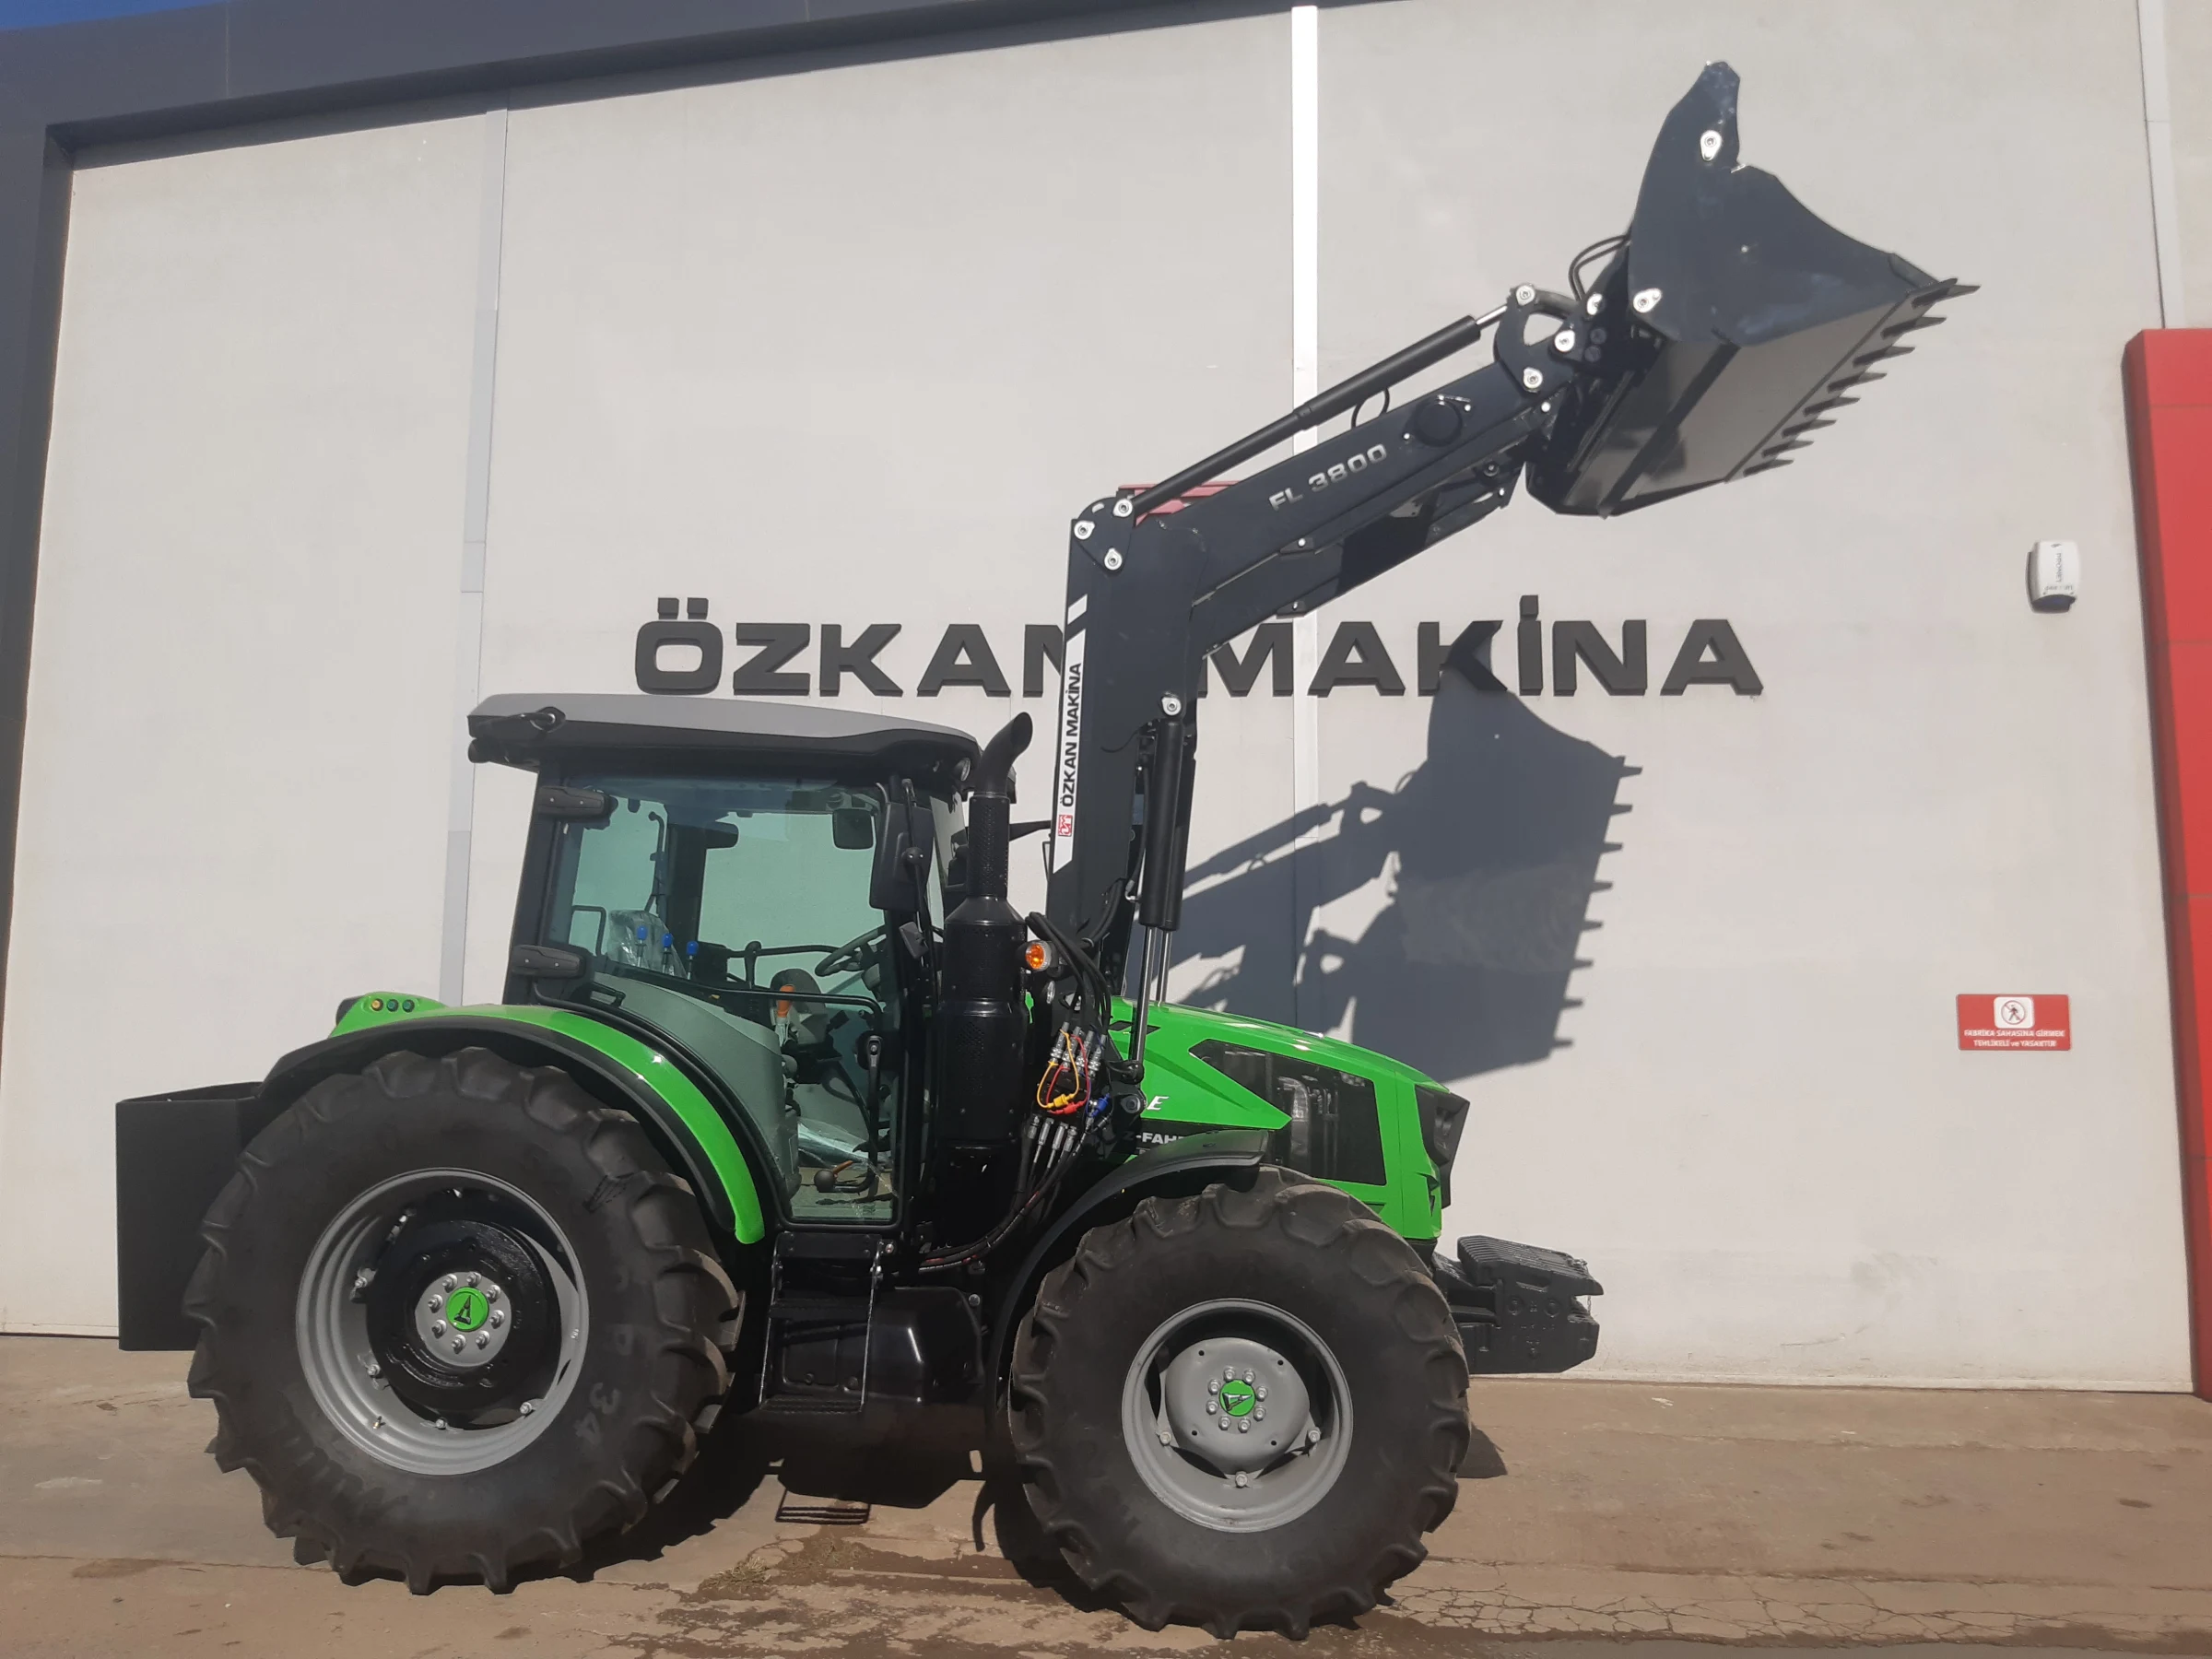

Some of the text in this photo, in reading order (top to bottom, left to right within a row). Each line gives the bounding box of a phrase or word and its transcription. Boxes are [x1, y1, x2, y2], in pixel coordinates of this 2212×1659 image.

[1268, 443, 1387, 512] FL 3800
[1197, 594, 1764, 698] MAKİNA
[1060, 663, 1082, 807] ÖZKAN MAKİNA
[1964, 1028, 2065, 1038] FABRİKA SAHASINA GİRMEK
[2020, 1039, 2057, 1047] YASAKTIR
